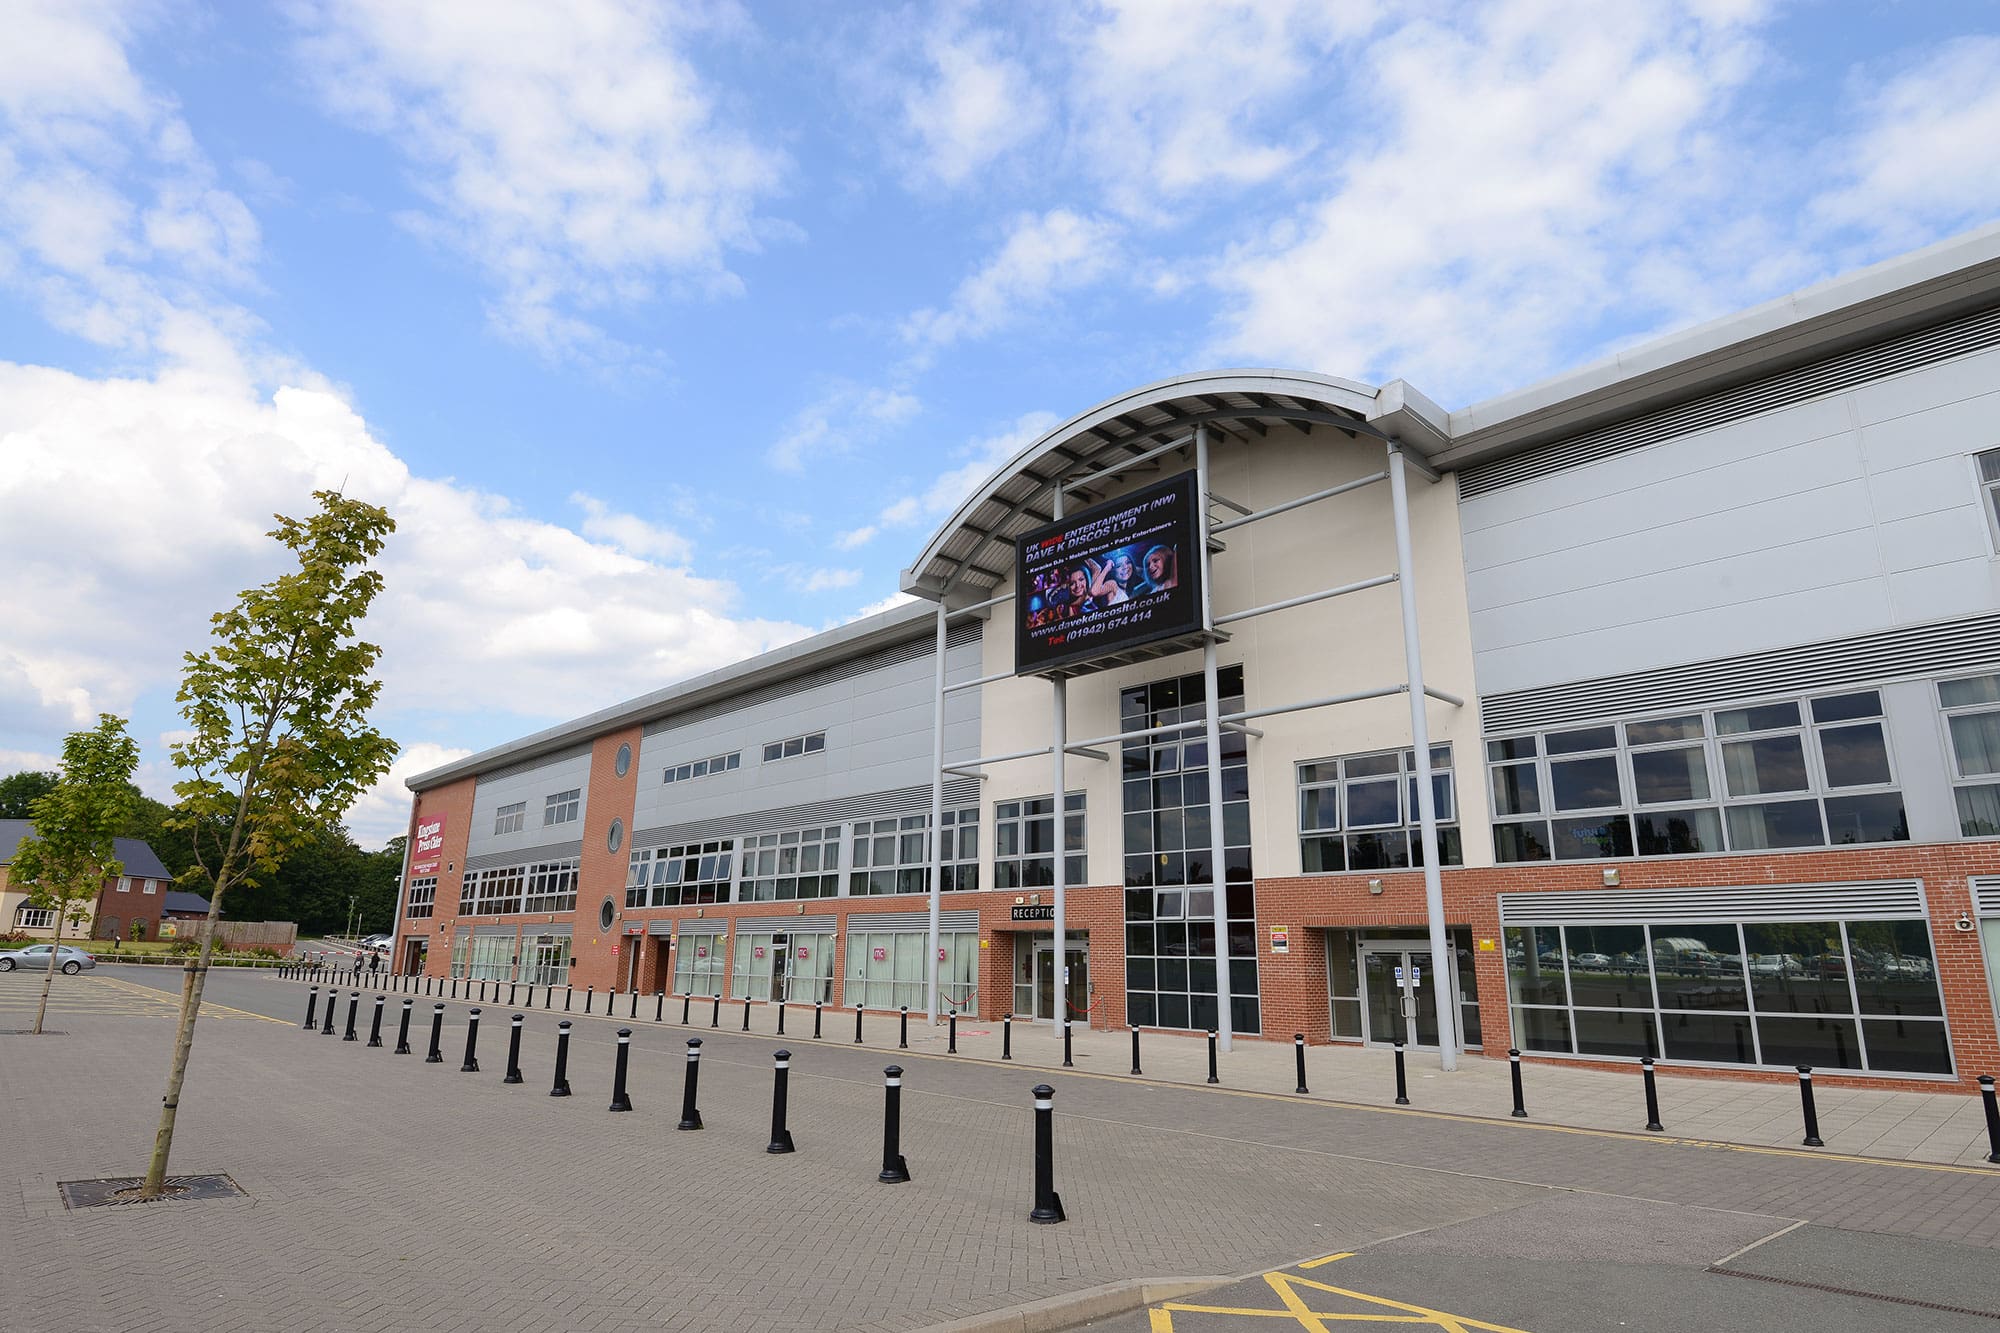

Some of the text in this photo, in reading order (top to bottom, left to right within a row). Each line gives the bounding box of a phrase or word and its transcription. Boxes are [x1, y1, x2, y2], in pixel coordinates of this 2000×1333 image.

[1025, 517, 1137, 563] DAVE K DISCOS LTD
[1026, 543, 1039, 554] UK
[1064, 502, 1149, 541] ENTERTAINMENT
[1150, 493, 1176, 511] (NW)
[1089, 543, 1110, 554] Discos
[1114, 536, 1131, 546] Party
[1132, 522, 1172, 539] Entertainers
[1031, 592, 1171, 639] www.davekdiscosltd.co.uk
[1066, 622, 1106, 643] (01942)
[1108, 616, 1128, 630] 674
[1130, 609, 1152, 623] 414
[1013, 908, 1056, 919] RECEPTIO
